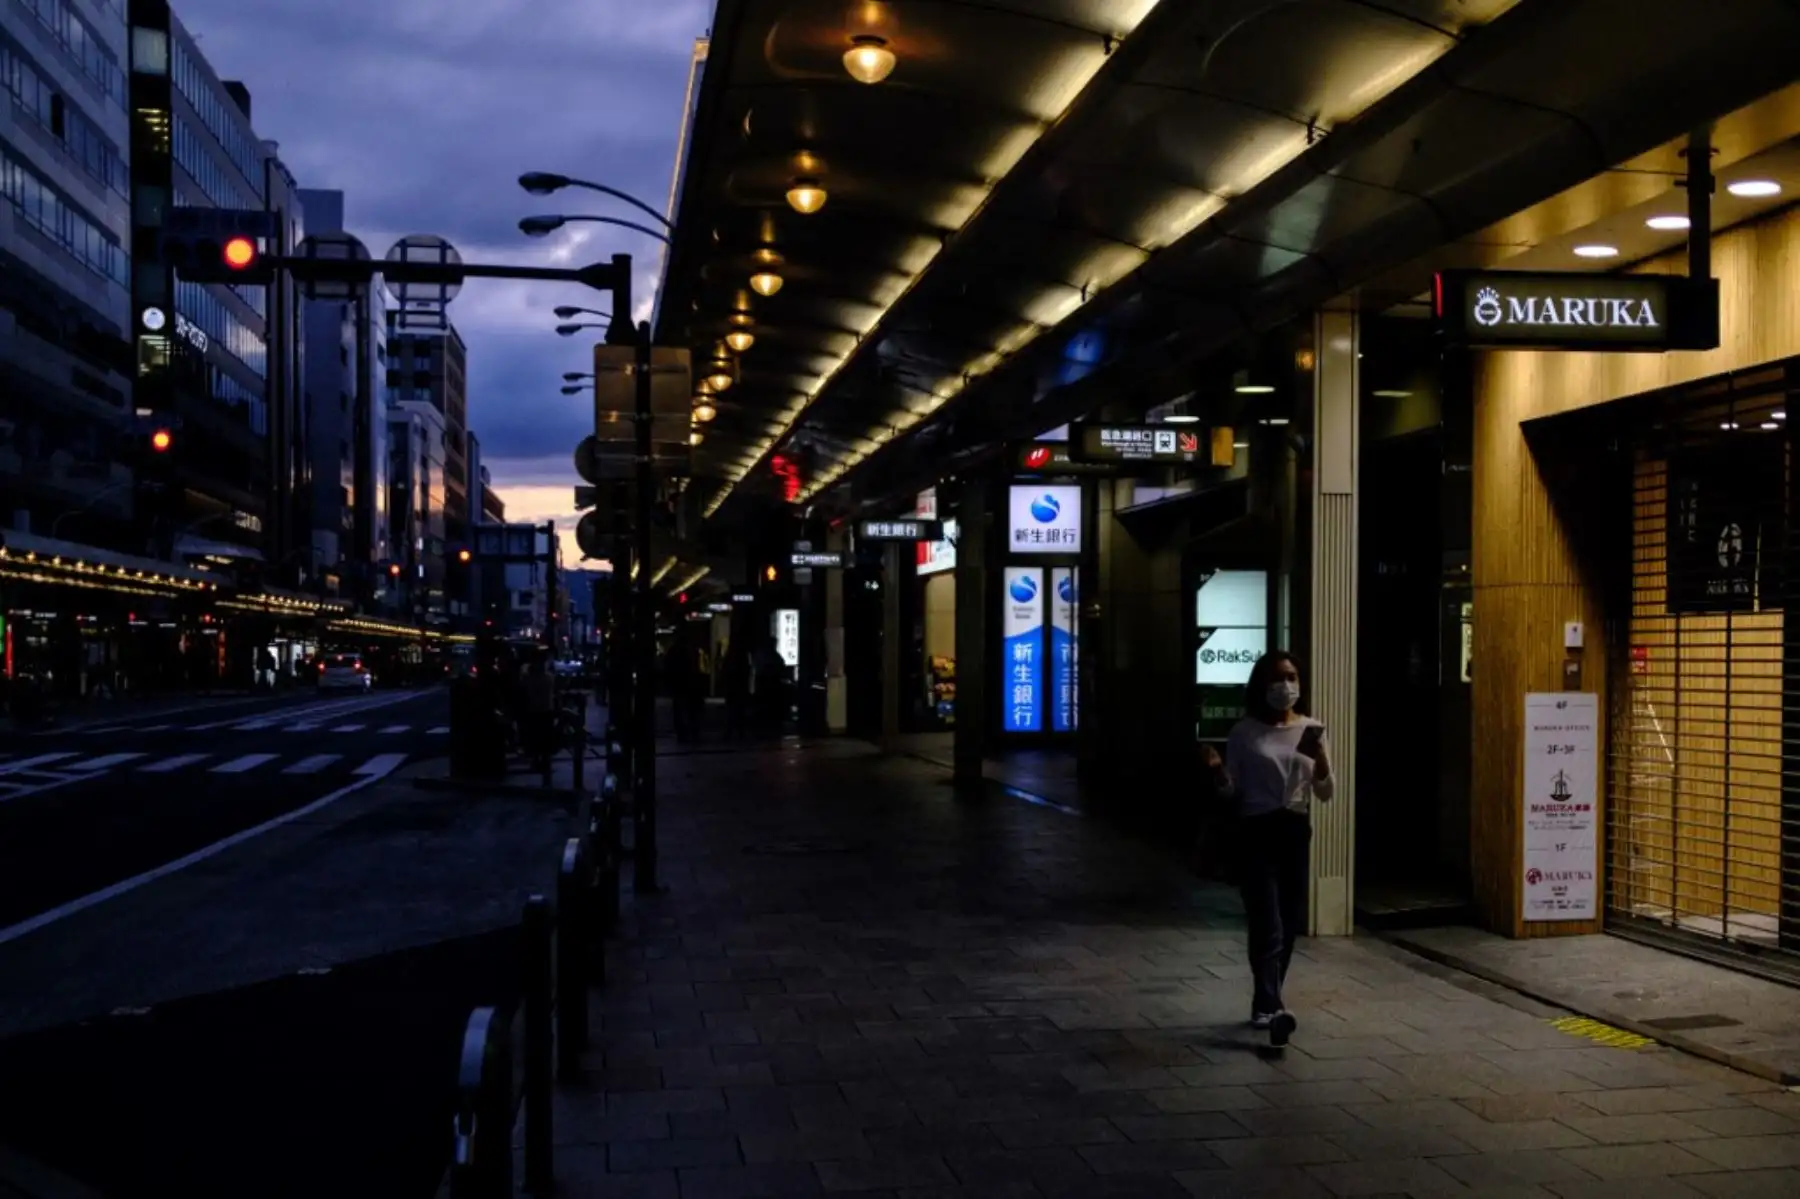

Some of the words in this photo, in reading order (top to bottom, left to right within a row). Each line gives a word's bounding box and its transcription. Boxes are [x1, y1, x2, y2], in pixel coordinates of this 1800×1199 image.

[1506, 296, 1659, 327] MARUKA
[1015, 528, 1077, 544] 新生銀行
[1012, 642, 1033, 727] 新生銀行
[1544, 871, 1593, 881] MARUKA
